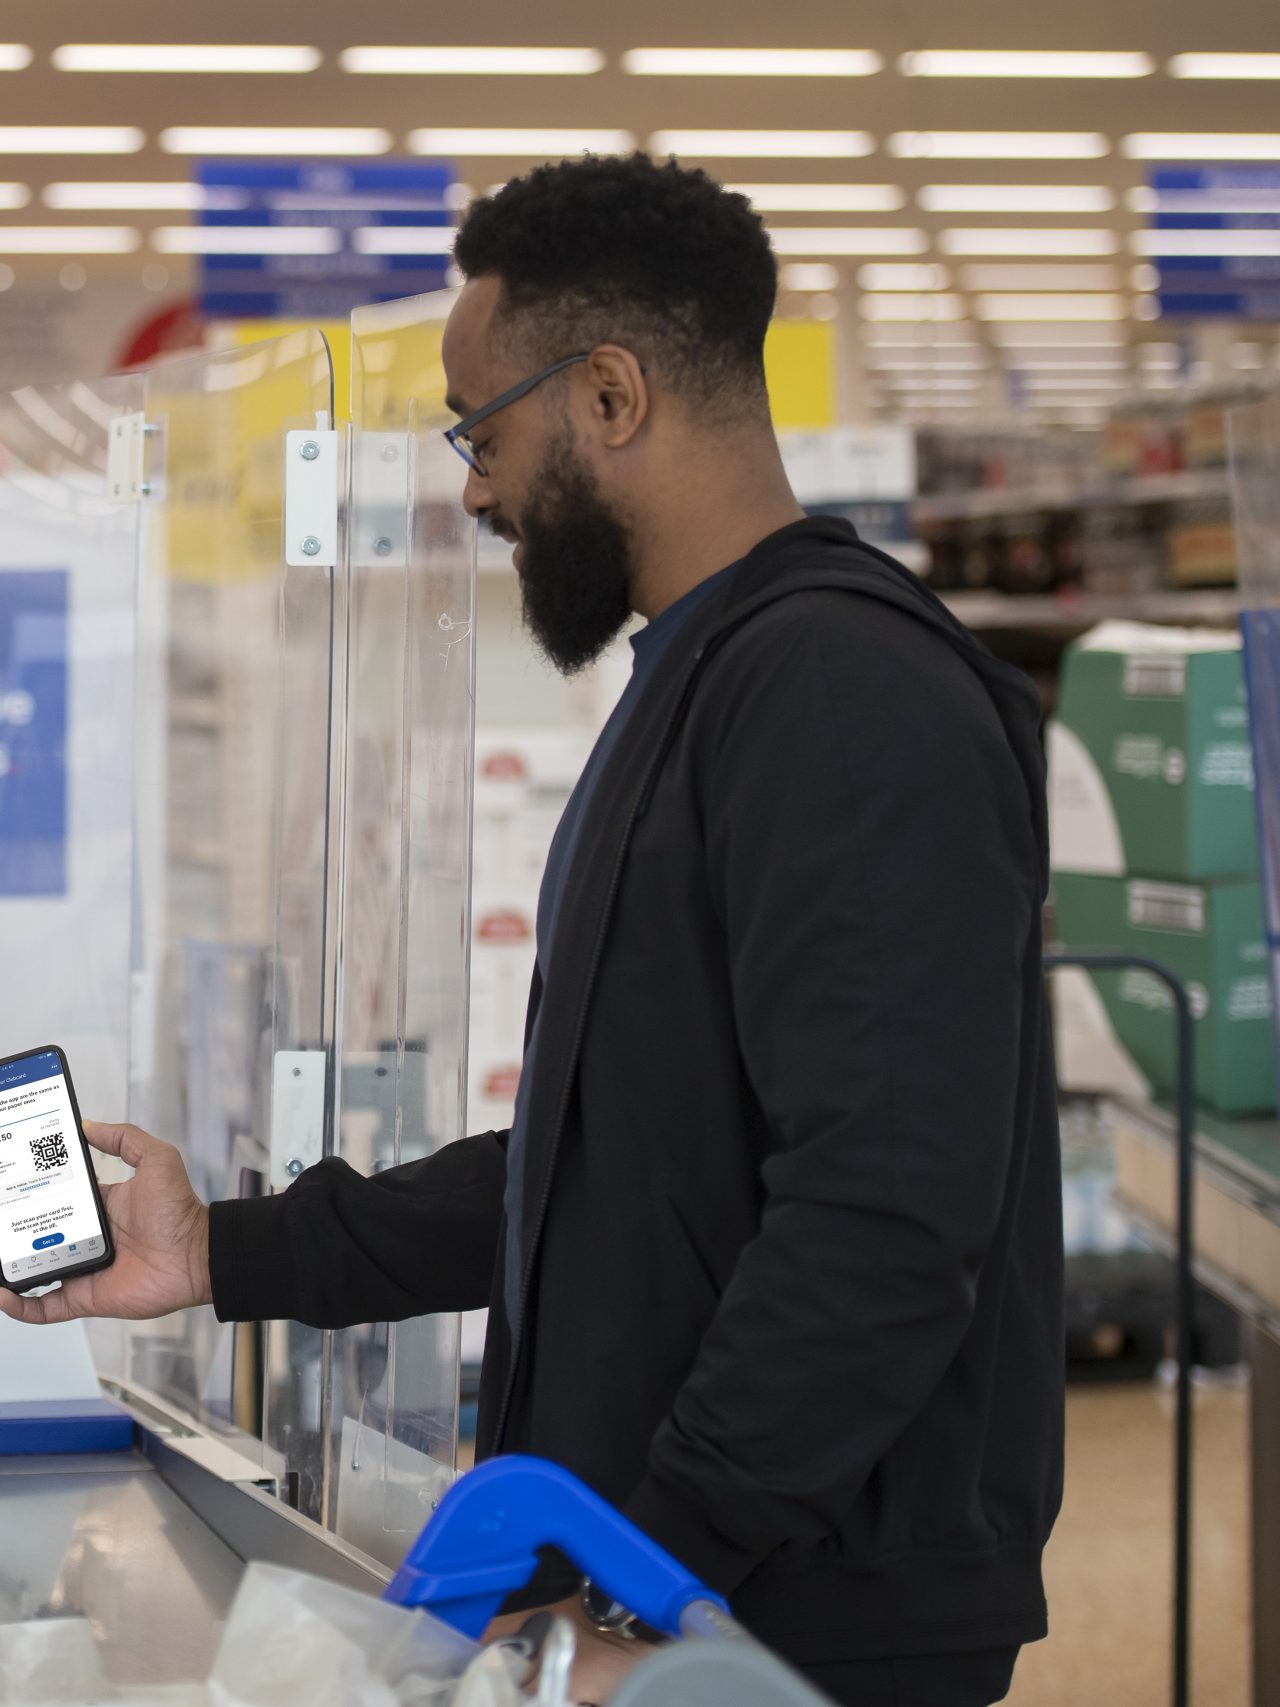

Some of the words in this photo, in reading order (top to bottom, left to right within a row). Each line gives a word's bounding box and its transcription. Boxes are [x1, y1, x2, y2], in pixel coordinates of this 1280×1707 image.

[38, 1087, 53, 1095] same
[7, 1102, 23, 1111] paper
[11, 1220, 23, 1228] Just
[23, 1216, 36, 1224] scan
[48, 1208, 61, 1216] card
[13, 1225, 27, 1233] then
[40, 1218, 52, 1226] your
[52, 1211, 74, 1222] voucher
